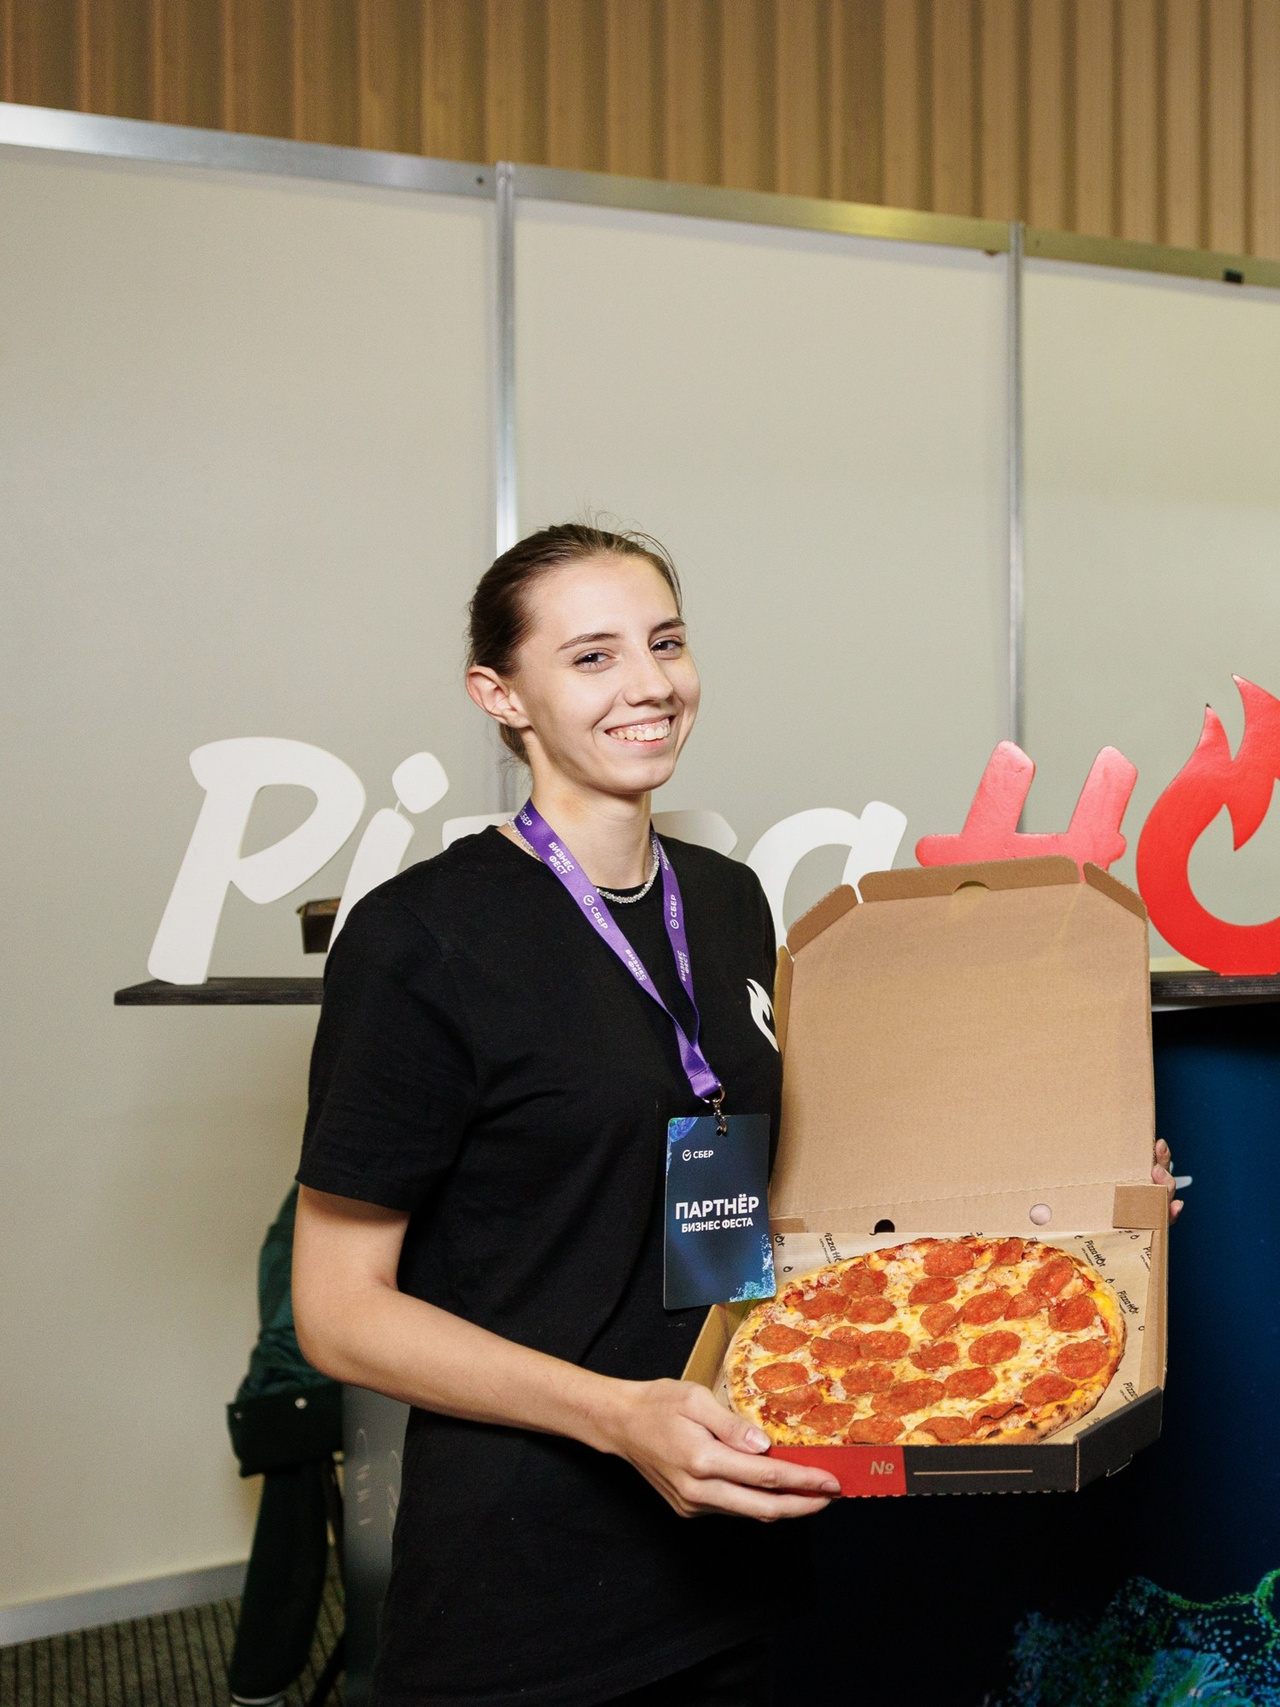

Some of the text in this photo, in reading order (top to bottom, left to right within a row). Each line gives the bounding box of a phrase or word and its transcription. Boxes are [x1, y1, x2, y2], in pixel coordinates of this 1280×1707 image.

[548, 841, 575, 872] БИЗНЕС
[549, 855, 568, 875] ФЕСТ
[591, 906, 609, 930] СБЕР
[670, 894, 678, 918] СБЕР
[692, 1150, 714, 1160] СБЕР
[675, 1193, 760, 1220] ПАРТНЁР
[681, 1217, 754, 1234] БИЗНЕС ФЕСТА
